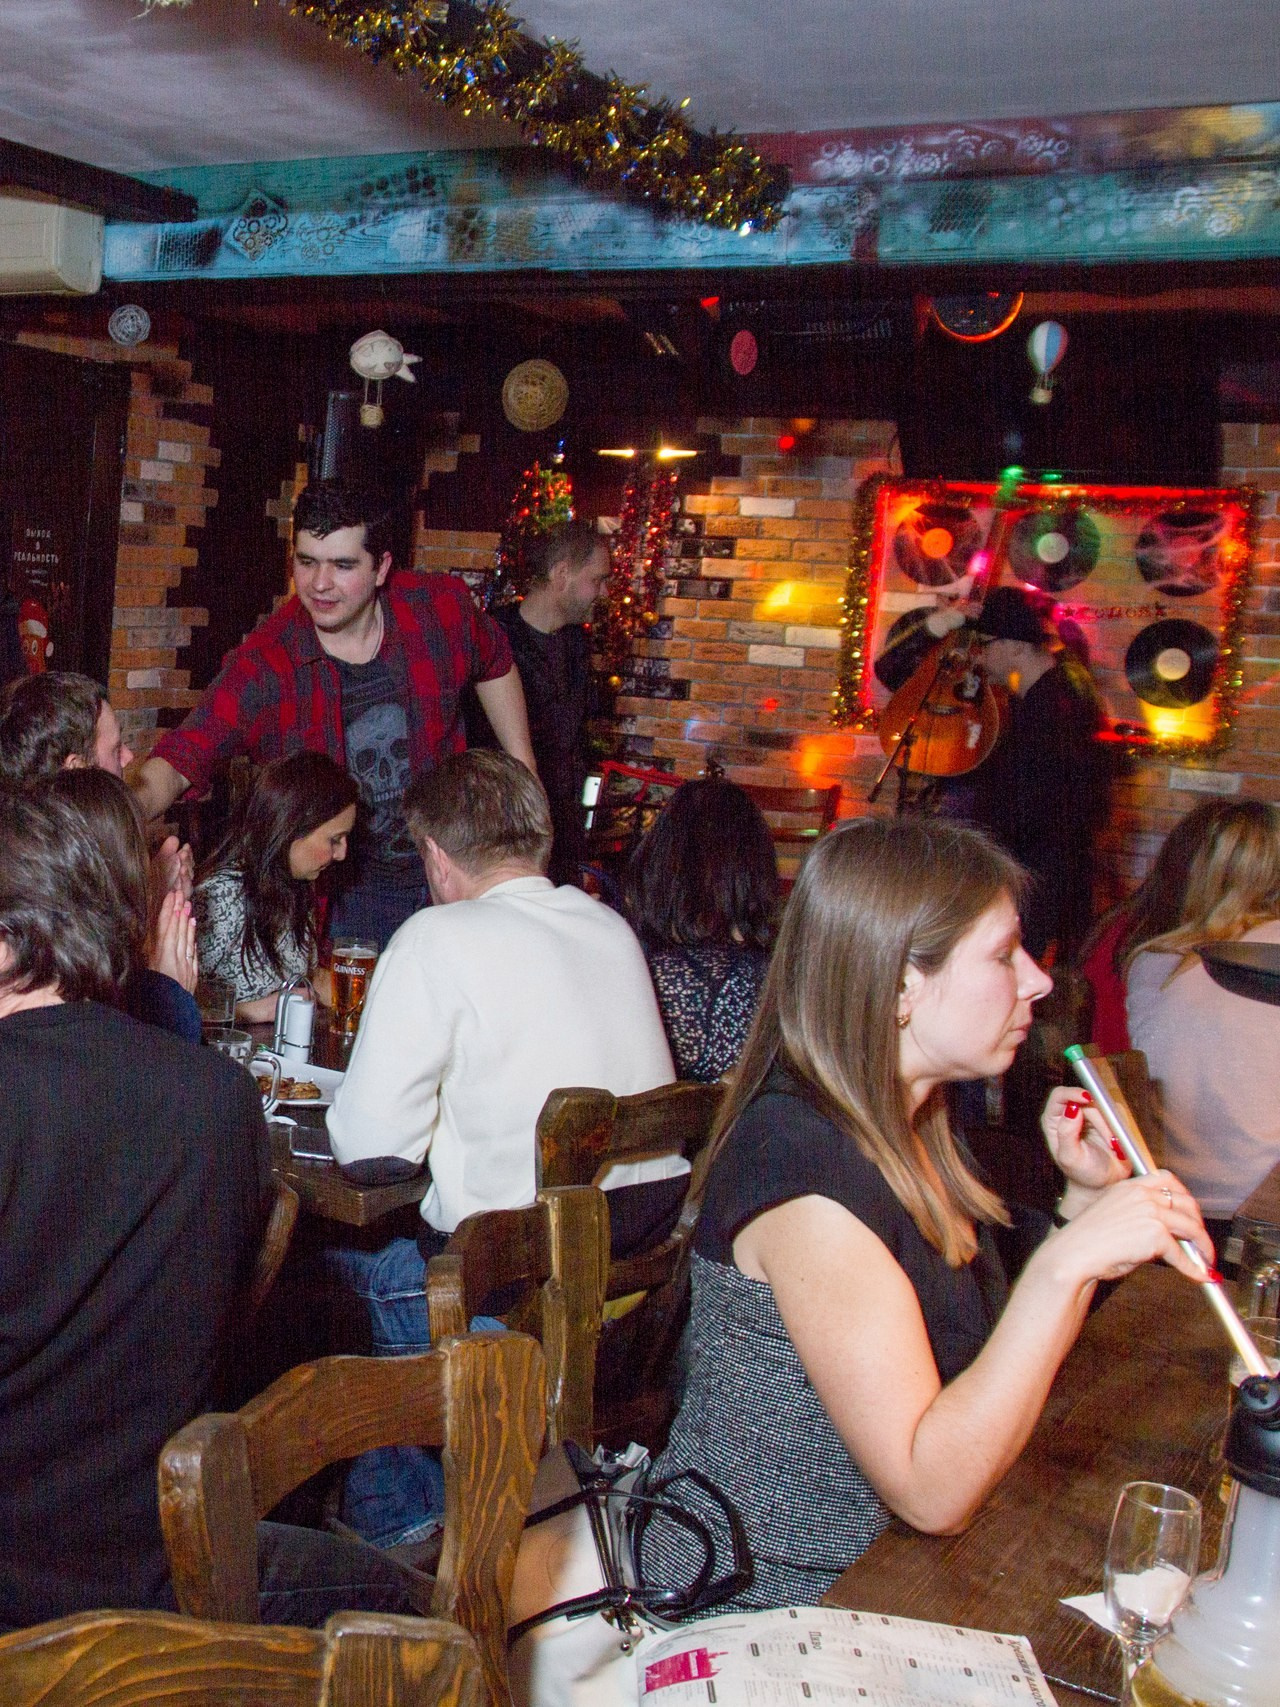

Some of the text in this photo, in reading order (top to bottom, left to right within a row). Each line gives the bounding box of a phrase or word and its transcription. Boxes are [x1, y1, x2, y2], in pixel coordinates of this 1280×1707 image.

[334, 963, 367, 976] GUINNESS
[808, 1631, 822, 1650] Пиво
[1008, 1639, 1036, 1677] Крепкий
